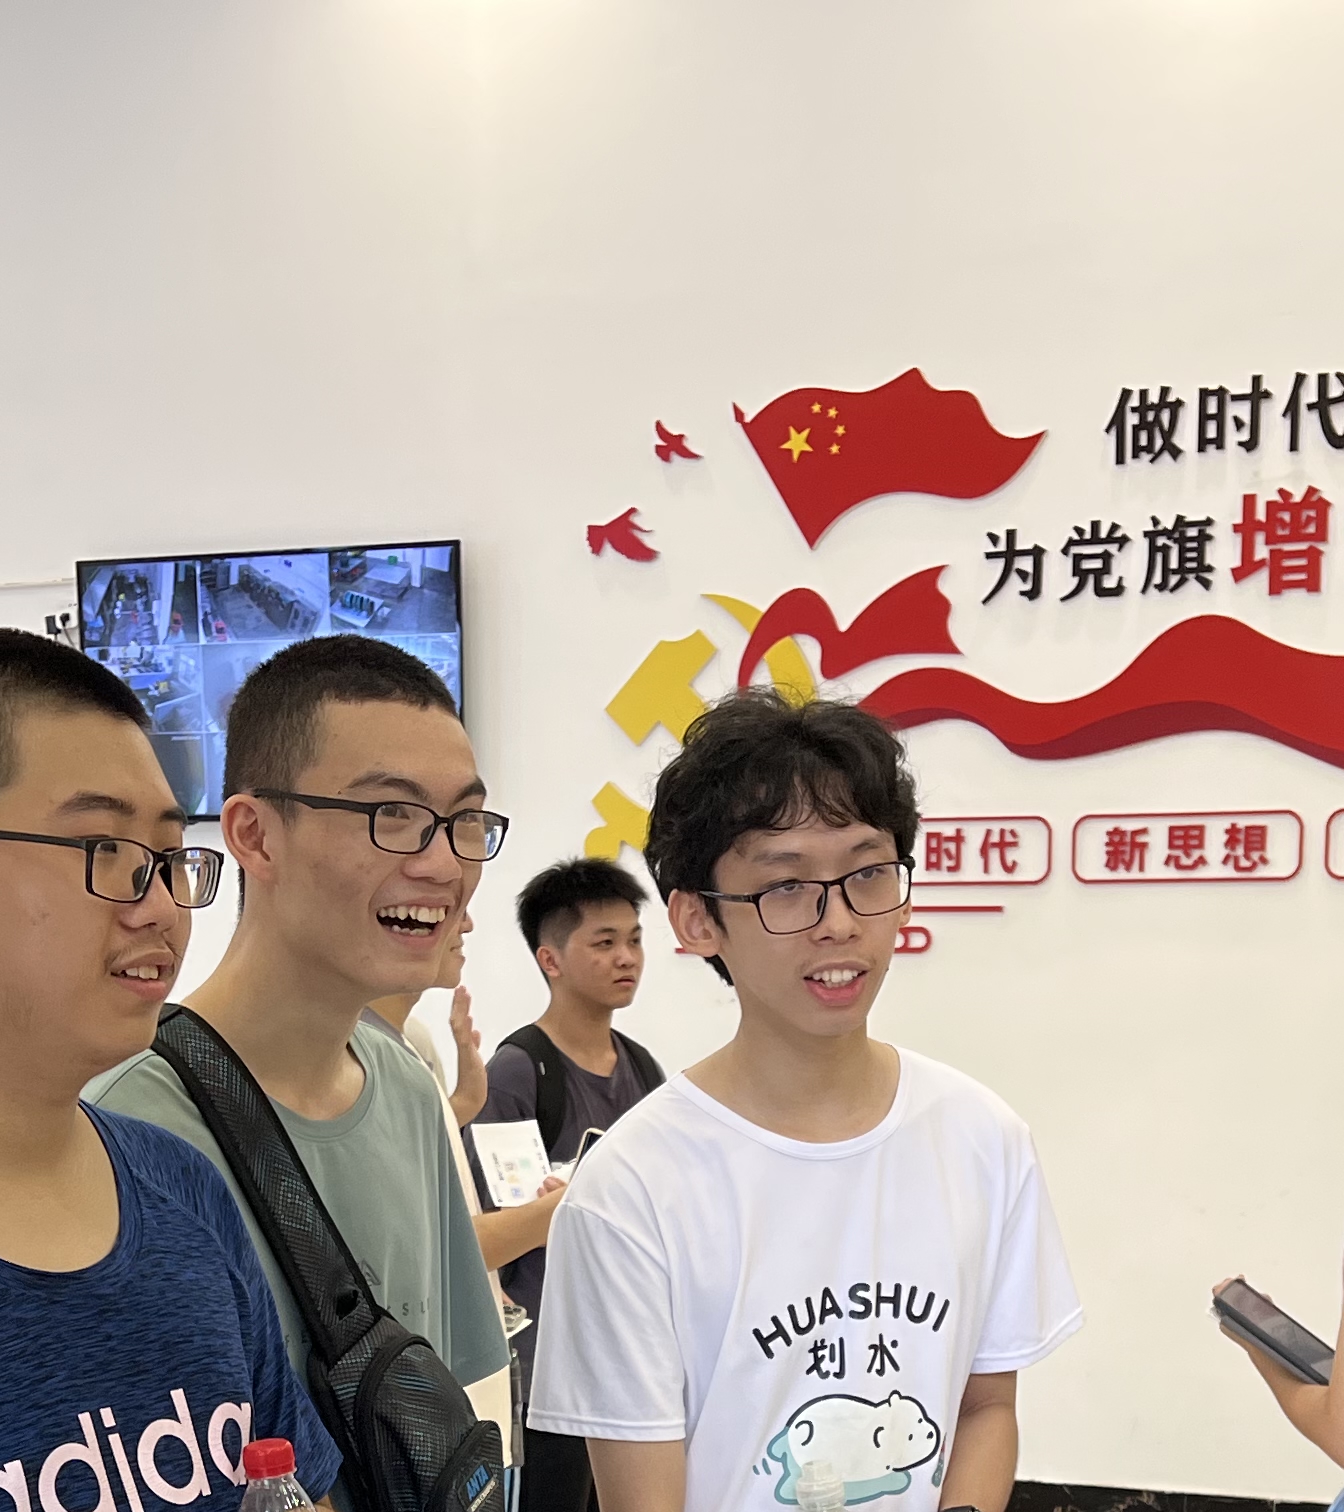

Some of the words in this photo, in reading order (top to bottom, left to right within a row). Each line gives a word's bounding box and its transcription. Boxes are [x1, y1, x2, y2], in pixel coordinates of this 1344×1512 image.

[924, 826, 1022, 876] 时代
[1104, 819, 1271, 876] 新思想
[752, 1281, 950, 1360] HUASHUI
[805, 1333, 901, 1380] 划水
